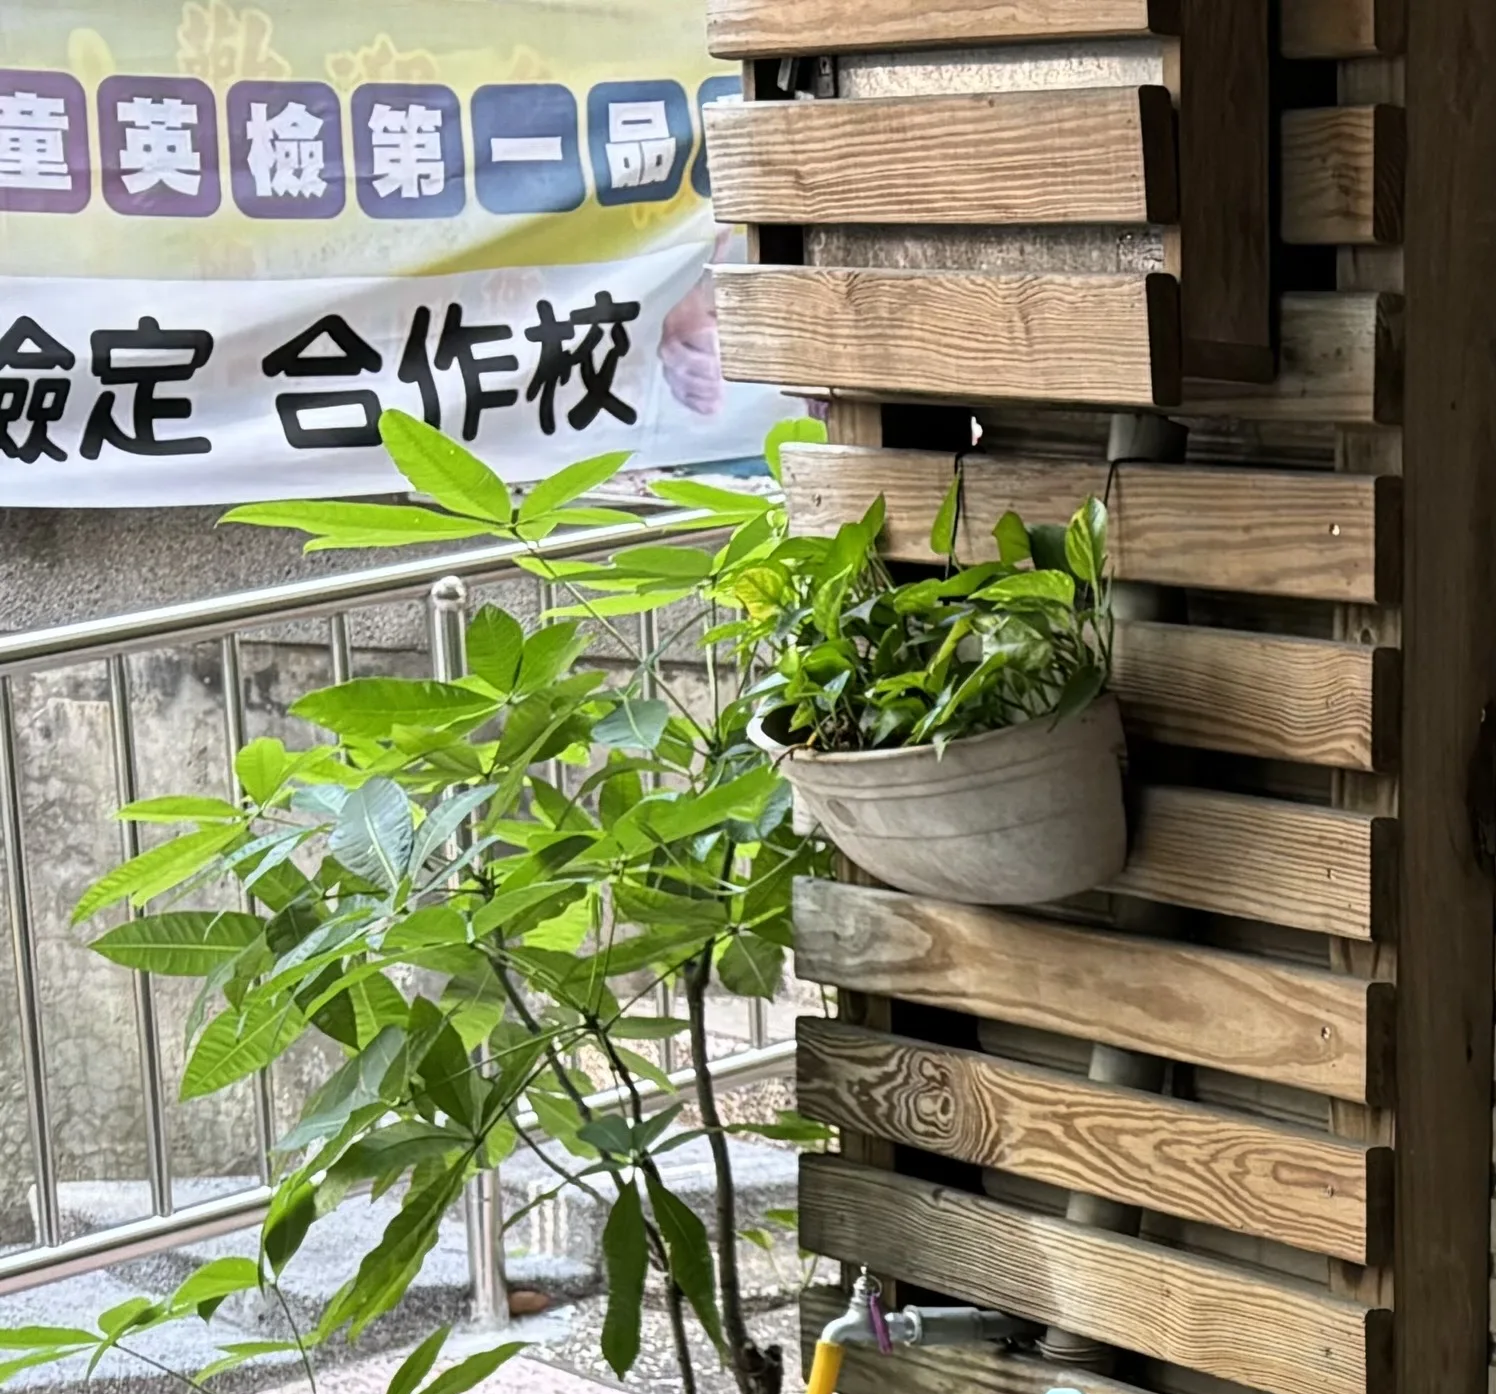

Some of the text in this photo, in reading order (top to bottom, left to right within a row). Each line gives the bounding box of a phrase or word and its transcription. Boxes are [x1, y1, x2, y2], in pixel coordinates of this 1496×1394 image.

[0, 93, 743, 199] 童英檢第一品
[262, 290, 641, 449] 合作校
